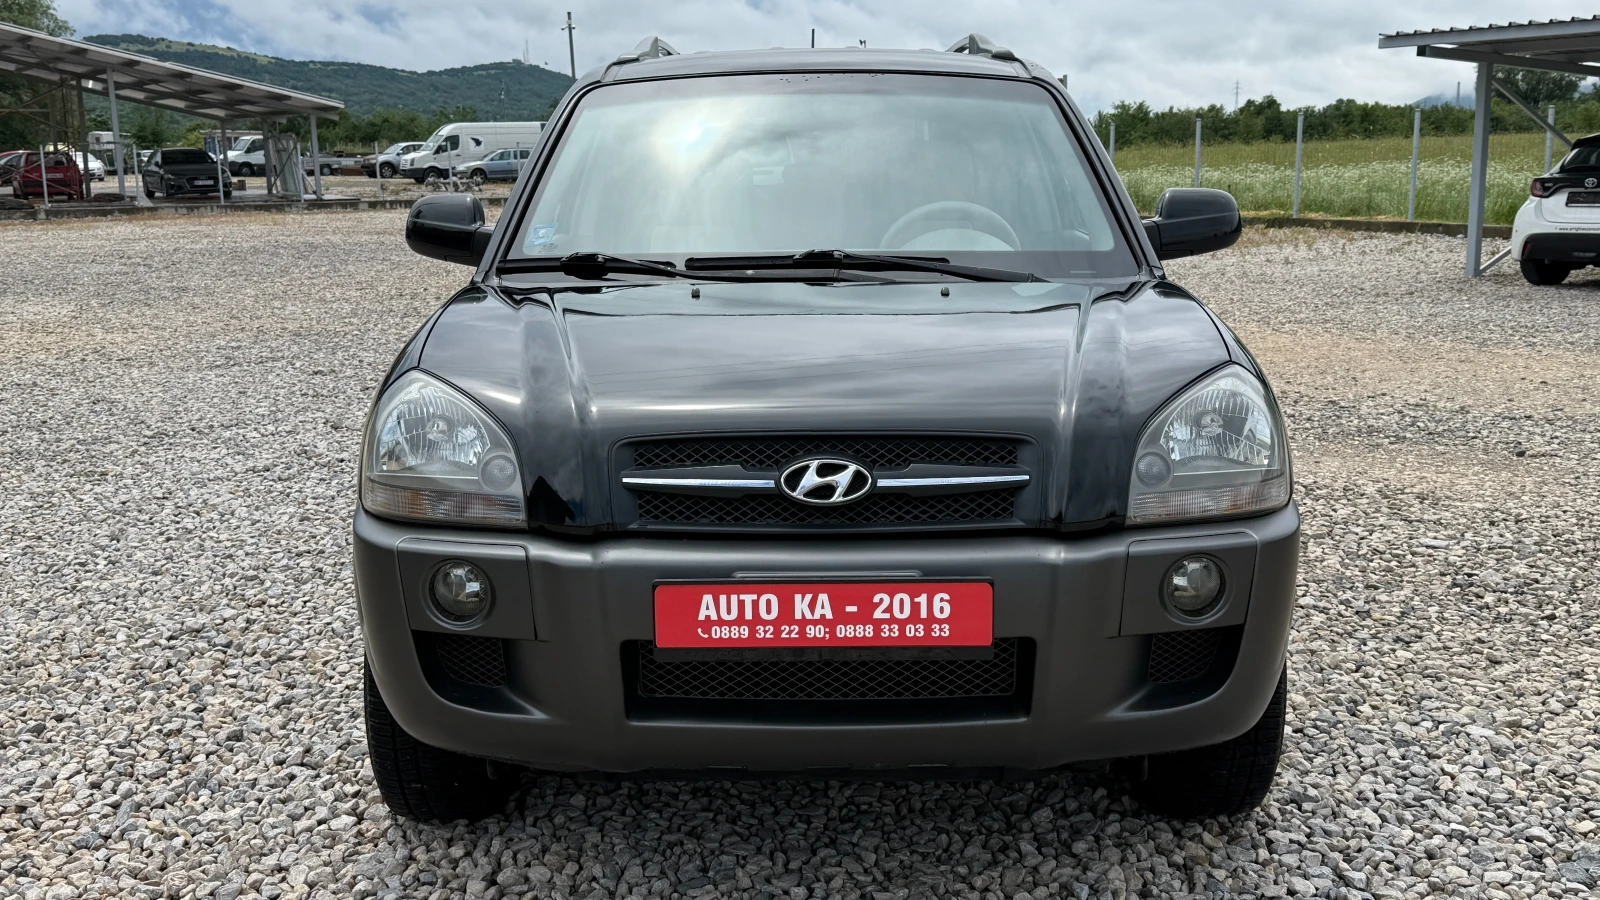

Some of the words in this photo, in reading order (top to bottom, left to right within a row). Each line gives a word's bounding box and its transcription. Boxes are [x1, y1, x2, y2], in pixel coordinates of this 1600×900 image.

[698, 594, 779, 621] AUTO
[794, 594, 833, 620] KA
[845, 605, 858, 613] -
[873, 593, 951, 619] 2016
[711, 626, 749, 639] 0889
[755, 626, 774, 639] 32
[780, 625, 799, 638] 22
[806, 625, 830, 640] 90;
[836, 624, 874, 638] 0888
[881, 624, 899, 637] 33
[905, 624, 924, 637] 03
[931, 624, 950, 637] 33
